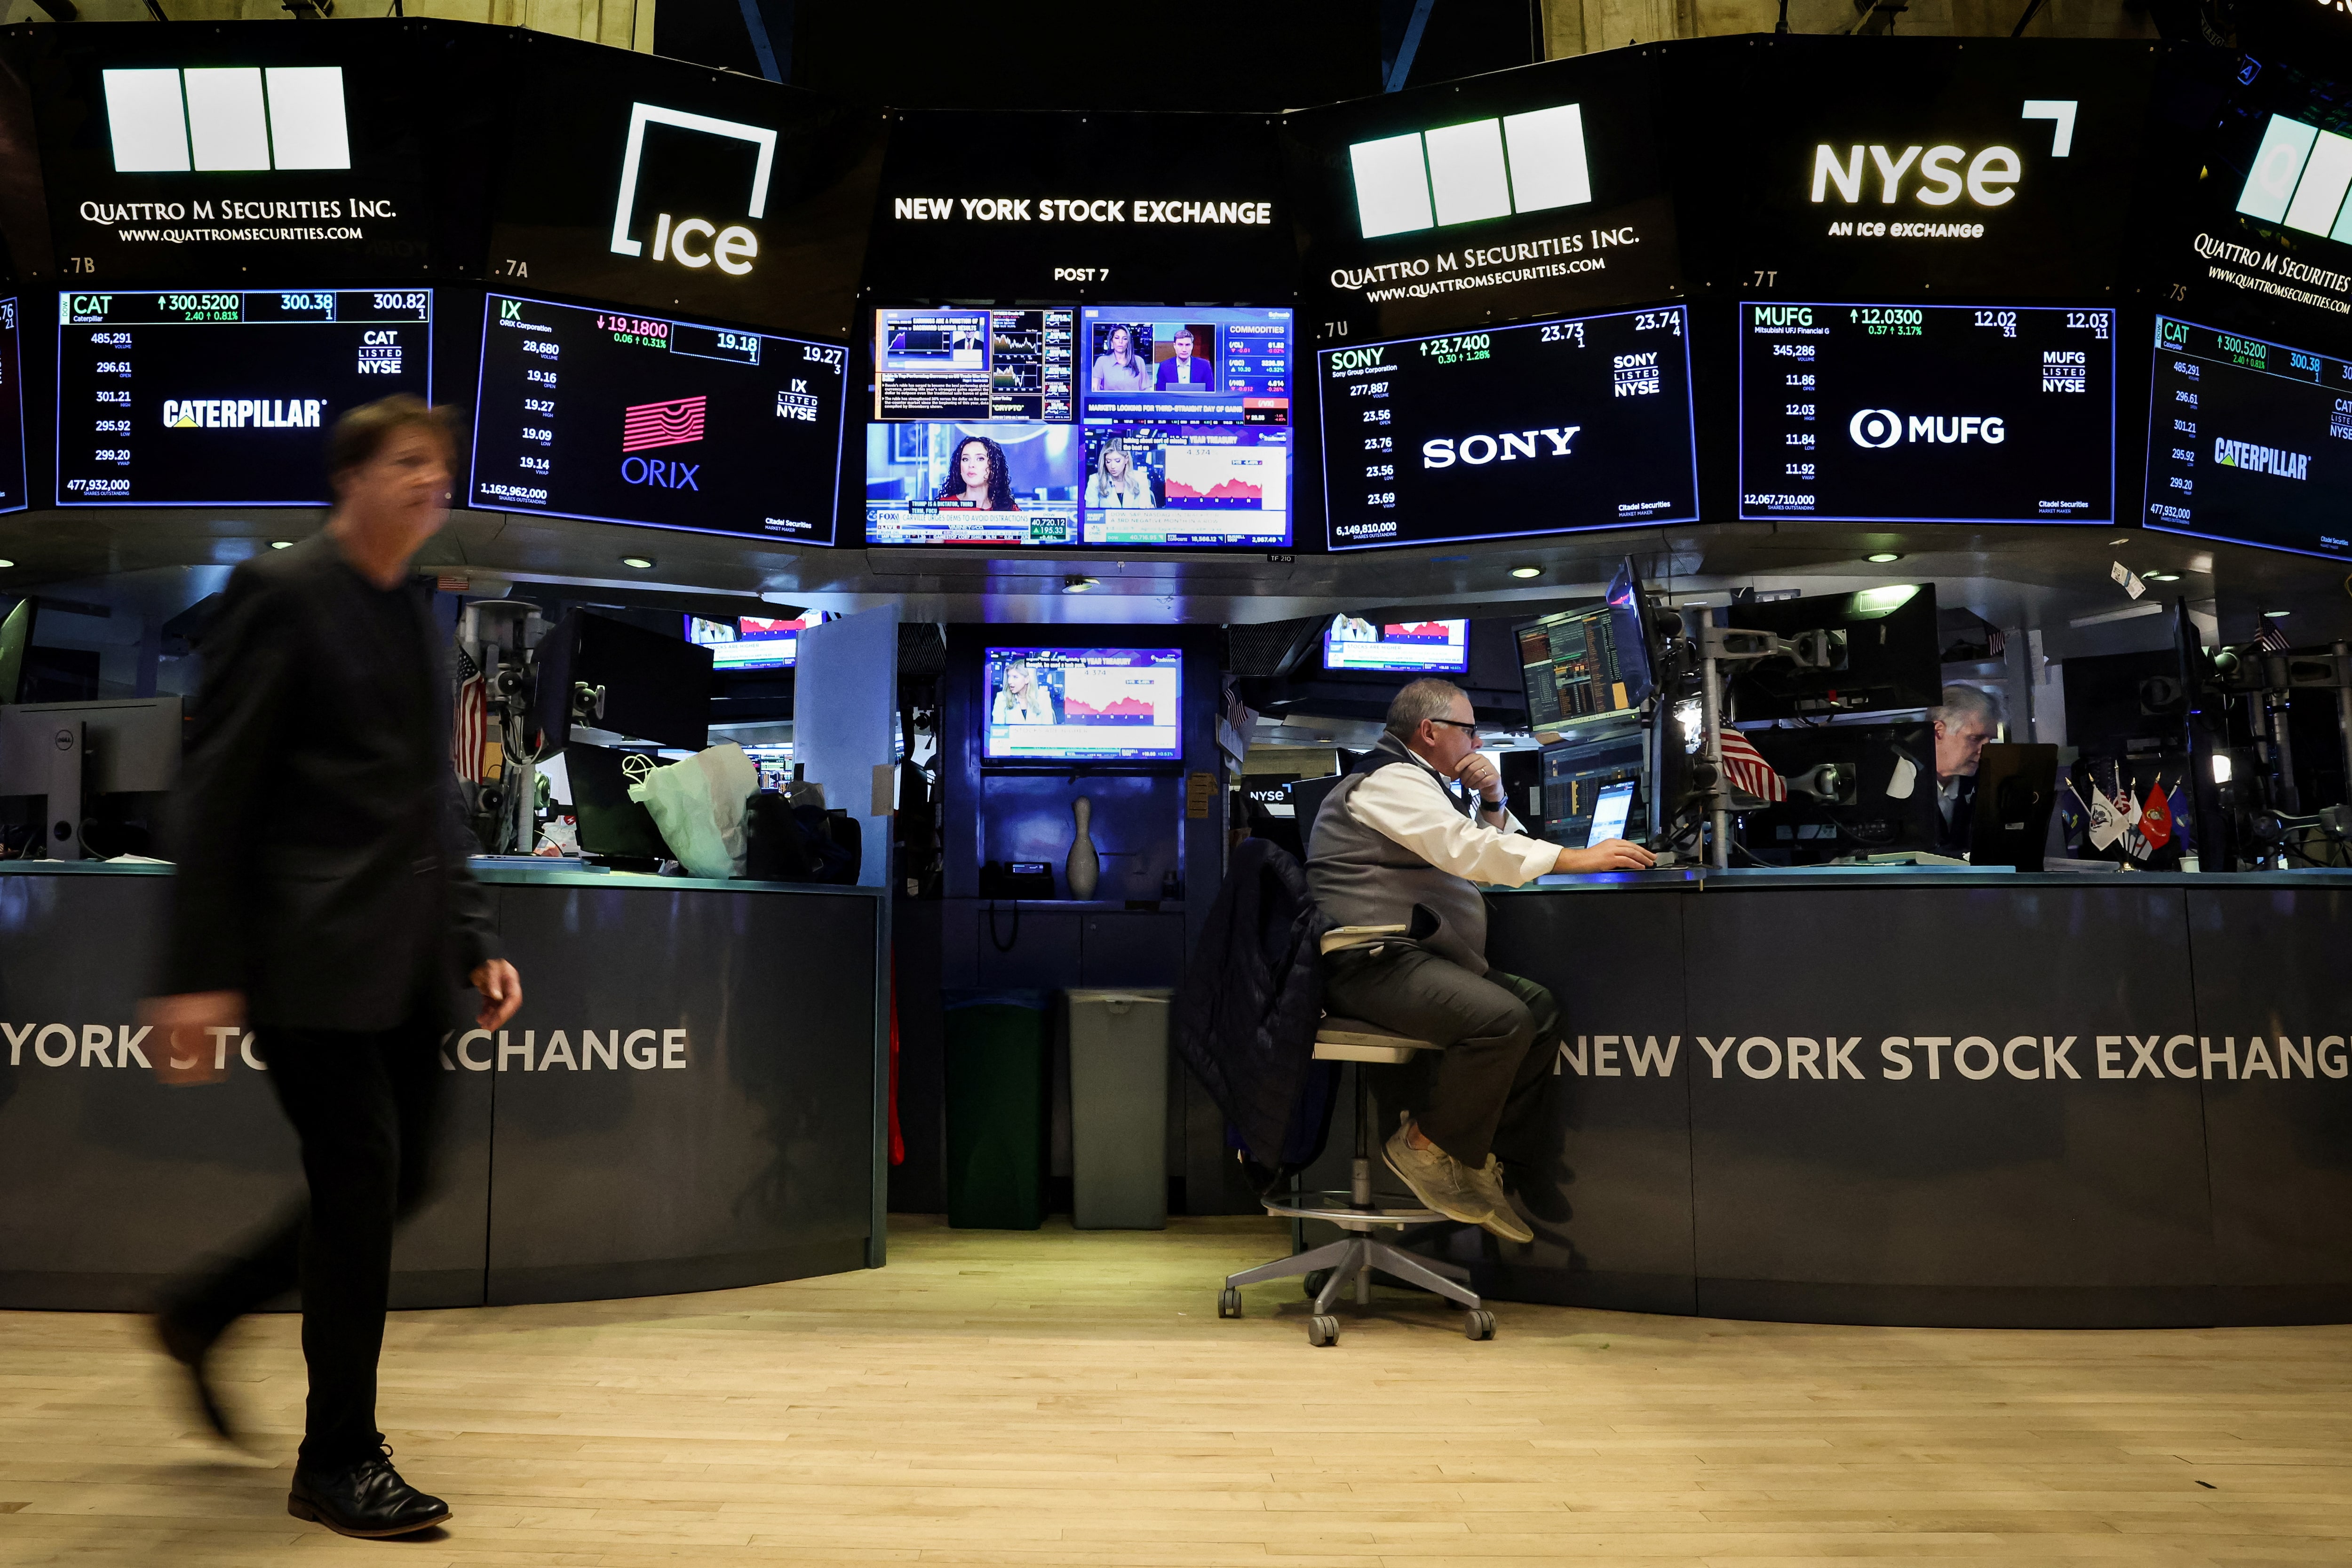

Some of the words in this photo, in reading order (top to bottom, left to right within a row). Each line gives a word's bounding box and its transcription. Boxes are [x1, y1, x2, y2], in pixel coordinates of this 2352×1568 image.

[80, 202, 185, 225] QUATTRO
[194, 201, 215, 219] M
[222, 200, 341, 219] SECURITIES
[350, 198, 396, 217] INC.
[895, 198, 953, 219] NEW
[961, 199, 1031, 220] YORK
[1039, 199, 1125, 222] STOCK
[1134, 201, 1271, 224] EXCHANGE
[1828, 222, 1852, 236] AN
[1331, 259, 1429, 289] QUATTRO
[1437, 253, 1458, 272] M
[1464, 235, 1583, 268] SECURITIES
[1591, 227, 1639, 249] INC.
[2194, 233, 2260, 267] QUATTRO
[2261, 253, 2277, 272] M
[71, 258, 95, 273] 7B
[507, 260, 527, 277] 7A
[1055, 268, 1095, 281] POST
[1100, 269, 1109, 281] 7
[1755, 271, 1777, 286] 7T
[2170, 284, 2186, 301] 7S
[74, 296, 112, 314] CAT
[169, 295, 238, 310] 300.5200
[281, 294, 333, 309] 300.38
[373, 293, 425, 309] 300.82
[185, 311, 204, 320] 2.40
[214, 311, 238, 320] 0.81%
[501, 300, 521, 320] IX
[1756, 307, 1812, 326] MUFG
[1862, 309, 1922, 325] 12.0300
[1635, 311, 1680, 331] 23.74
[1975, 311, 2017, 327] 12.02
[2066, 313, 2108, 328] 12.03
[516, 322, 552, 333] Corporation
[608, 316, 667, 338] 19.1800
[1325, 321, 1347, 337] 7U
[1541, 323, 1584, 341] 23.73
[1869, 326, 1887, 334] 0.37
[1898, 326, 1922, 335] 3.17%
[2165, 323, 2189, 343] CAT
[91, 333, 132, 344] 485,291
[364, 331, 397, 345] CAT
[614, 333, 632, 343] 0.06
[643, 337, 666, 348] 0.31%
[717, 333, 757, 351] 19.18
[1431, 334, 1489, 355] 23.7400
[523, 341, 559, 355] 28,680
[1773, 345, 1815, 357] 345,286
[2224, 336, 2265, 358] 300.5200
[803, 346, 842, 364] 19.27
[1332, 347, 1384, 370] SONY
[1438, 354, 1456, 364] 0.30
[1467, 350, 1490, 361] 1.28%
[1614, 352, 1657, 368] SONY
[2044, 352, 2085, 364] MUFG
[2290, 353, 2320, 372] 300.38
[97, 362, 131, 372] 296.61
[358, 360, 401, 373] NYSE
[1365, 365, 1397, 373] Corporation
[2174, 362, 2200, 376] 485,291
[527, 370, 556, 383] 19.16
[1614, 369, 1659, 381] LISTED
[1787, 375, 1815, 385] 11.86
[792, 379, 807, 393] IX
[1351, 382, 1389, 398] 277,887
[1615, 380, 1660, 397] NYSE
[2043, 376, 2085, 392] NYSE
[96, 391, 131, 402] 301.21
[778, 394, 818, 406] LISTED
[525, 399, 554, 412] 19.27
[777, 404, 817, 421] NYSE
[1787, 404, 1814, 415] 12.03
[1363, 410, 1390, 422] 23.56
[96, 420, 130, 431] 295.92
[1909, 416, 2004, 443] MUFG
[523, 428, 552, 441] 19.09
[1786, 434, 1815, 444] 11.84
[1365, 437, 1392, 449] 23.76
[1423, 426, 1580, 468] SONY
[95, 450, 130, 460] 299.20
[520, 457, 549, 469] 19.14
[1786, 464, 1814, 474] 11.92
[621, 457, 699, 491] ORIX
[1367, 465, 1393, 477] 23.56
[67, 480, 129, 491] 477,932,000
[481, 483, 547, 499] 1,162,962,000
[1368, 492, 1395, 504] 23.69
[1745, 494, 1814, 505] 12,067,710,000
[2151, 504, 2190, 519] 477,932,000
[1336, 522, 1397, 536] 6,149,810,000
[0, 1023, 153, 1068] YORK
[438, 1028, 687, 1072] XCHANGE
[1554, 1036, 1680, 1077] NEW
[1696, 1037, 1865, 1079] YORK
[1881, 1036, 2081, 1080] STOCK
[2096, 1035, 2352, 1079] EXCHANG
